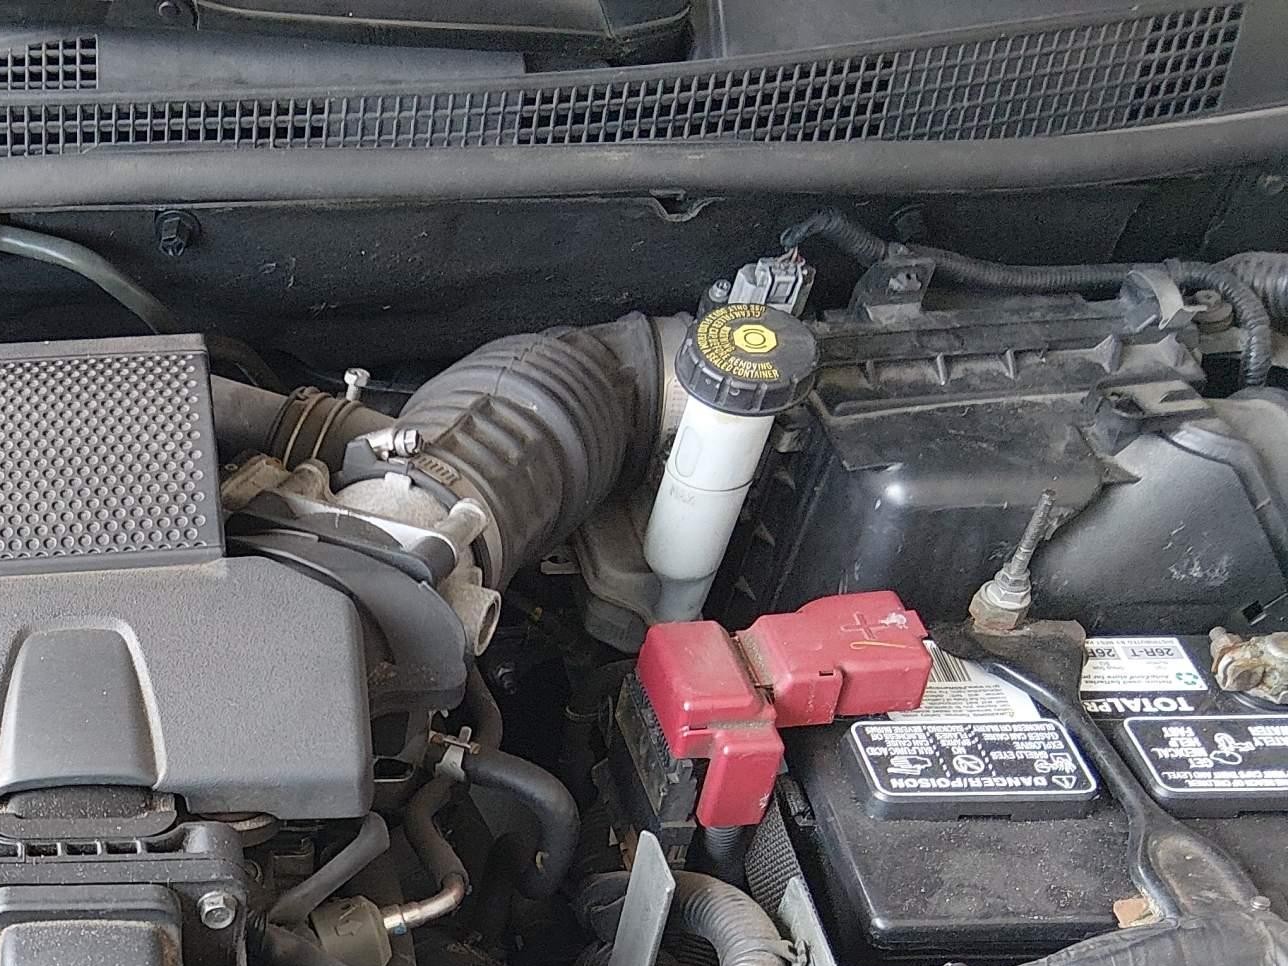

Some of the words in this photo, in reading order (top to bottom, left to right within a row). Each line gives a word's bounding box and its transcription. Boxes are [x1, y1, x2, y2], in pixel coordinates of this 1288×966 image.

[750, 304, 767, 312] USE
[728, 356, 773, 370] REMOVING
[732, 366, 779, 381] CONTAINER
[1130, 647, 1174, 657] 26R-T
[1012, 741, 1064, 749] EXPLOSIVE
[1168, 737, 1202, 747] HELP
[865, 746, 888, 756] ACID
[989, 751, 1016, 760] EYES
[1015, 751, 1049, 760] SHIELD
[1150, 747, 1208, 758] MEDICAL
[1188, 758, 1214, 768] GET
[890, 776, 1048, 788] DANGER/POISON
